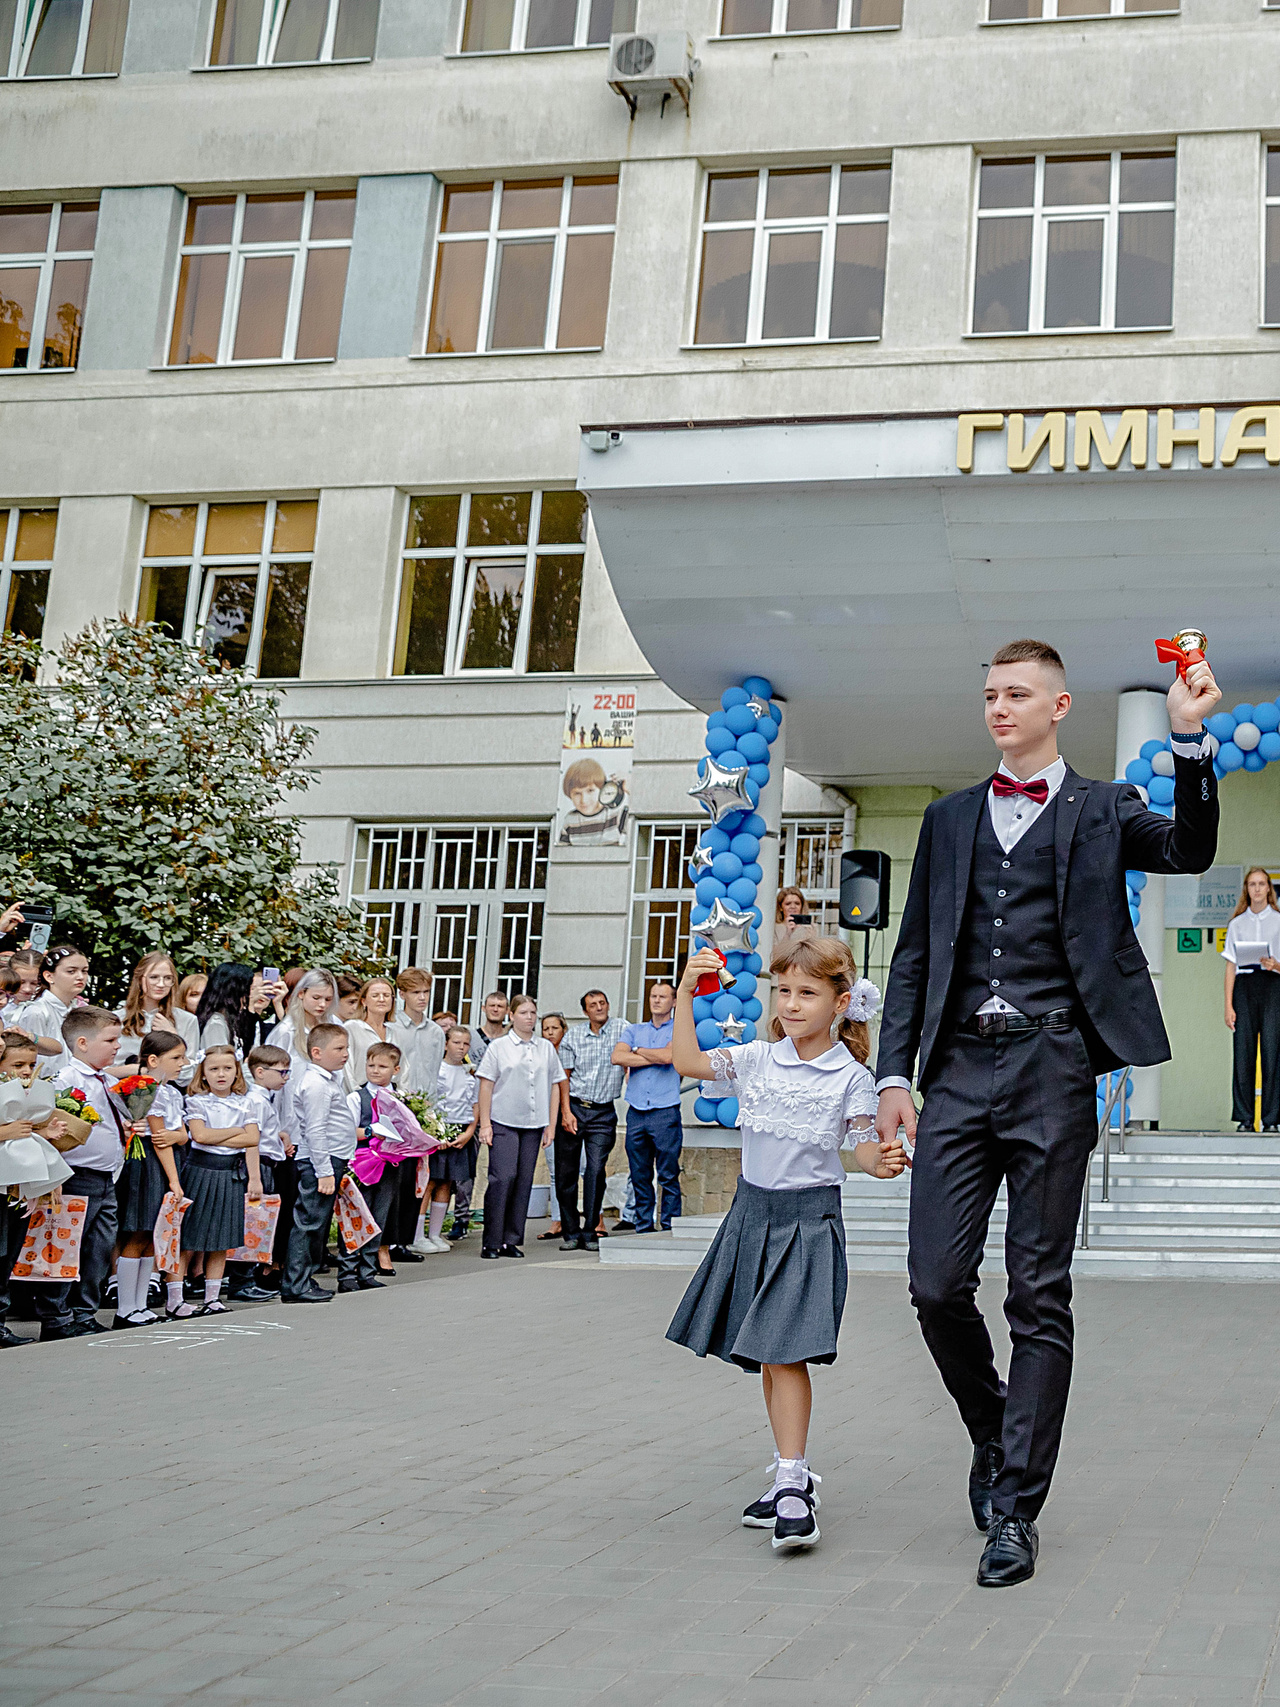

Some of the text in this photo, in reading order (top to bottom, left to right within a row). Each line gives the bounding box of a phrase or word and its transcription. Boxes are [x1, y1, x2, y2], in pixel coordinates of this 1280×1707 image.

[593, 693, 636, 710] 22-00
[610, 711, 635, 719] ВАШИ
[612, 720, 634, 728] ДЕТИ
